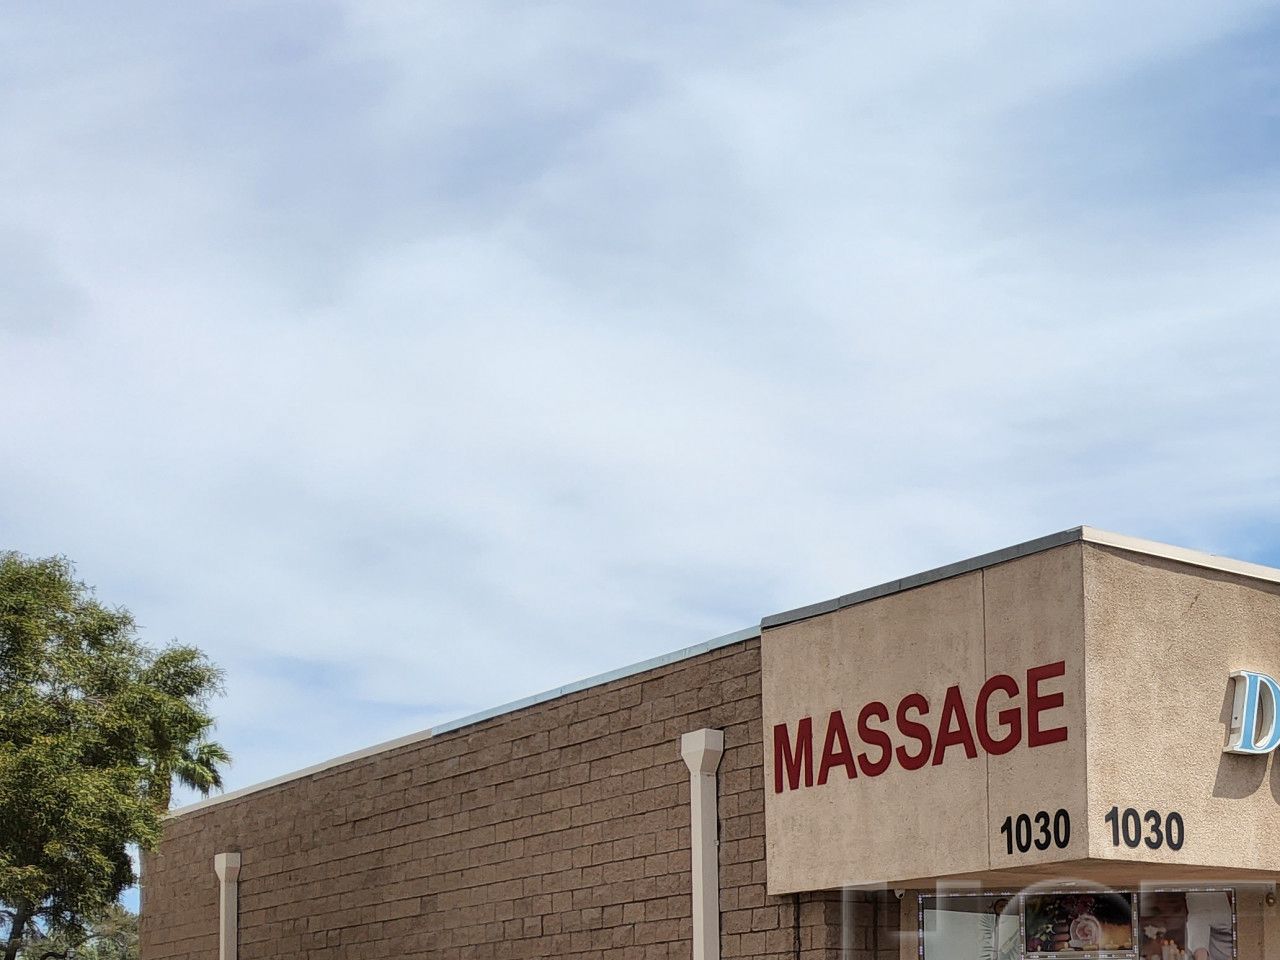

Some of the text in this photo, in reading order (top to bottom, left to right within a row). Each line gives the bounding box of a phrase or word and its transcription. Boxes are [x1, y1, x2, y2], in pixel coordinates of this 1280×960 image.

[773, 660, 1068, 793] MASSAGE
[1000, 808, 1071, 855] 1030
[1105, 806, 1185, 851] 1030
